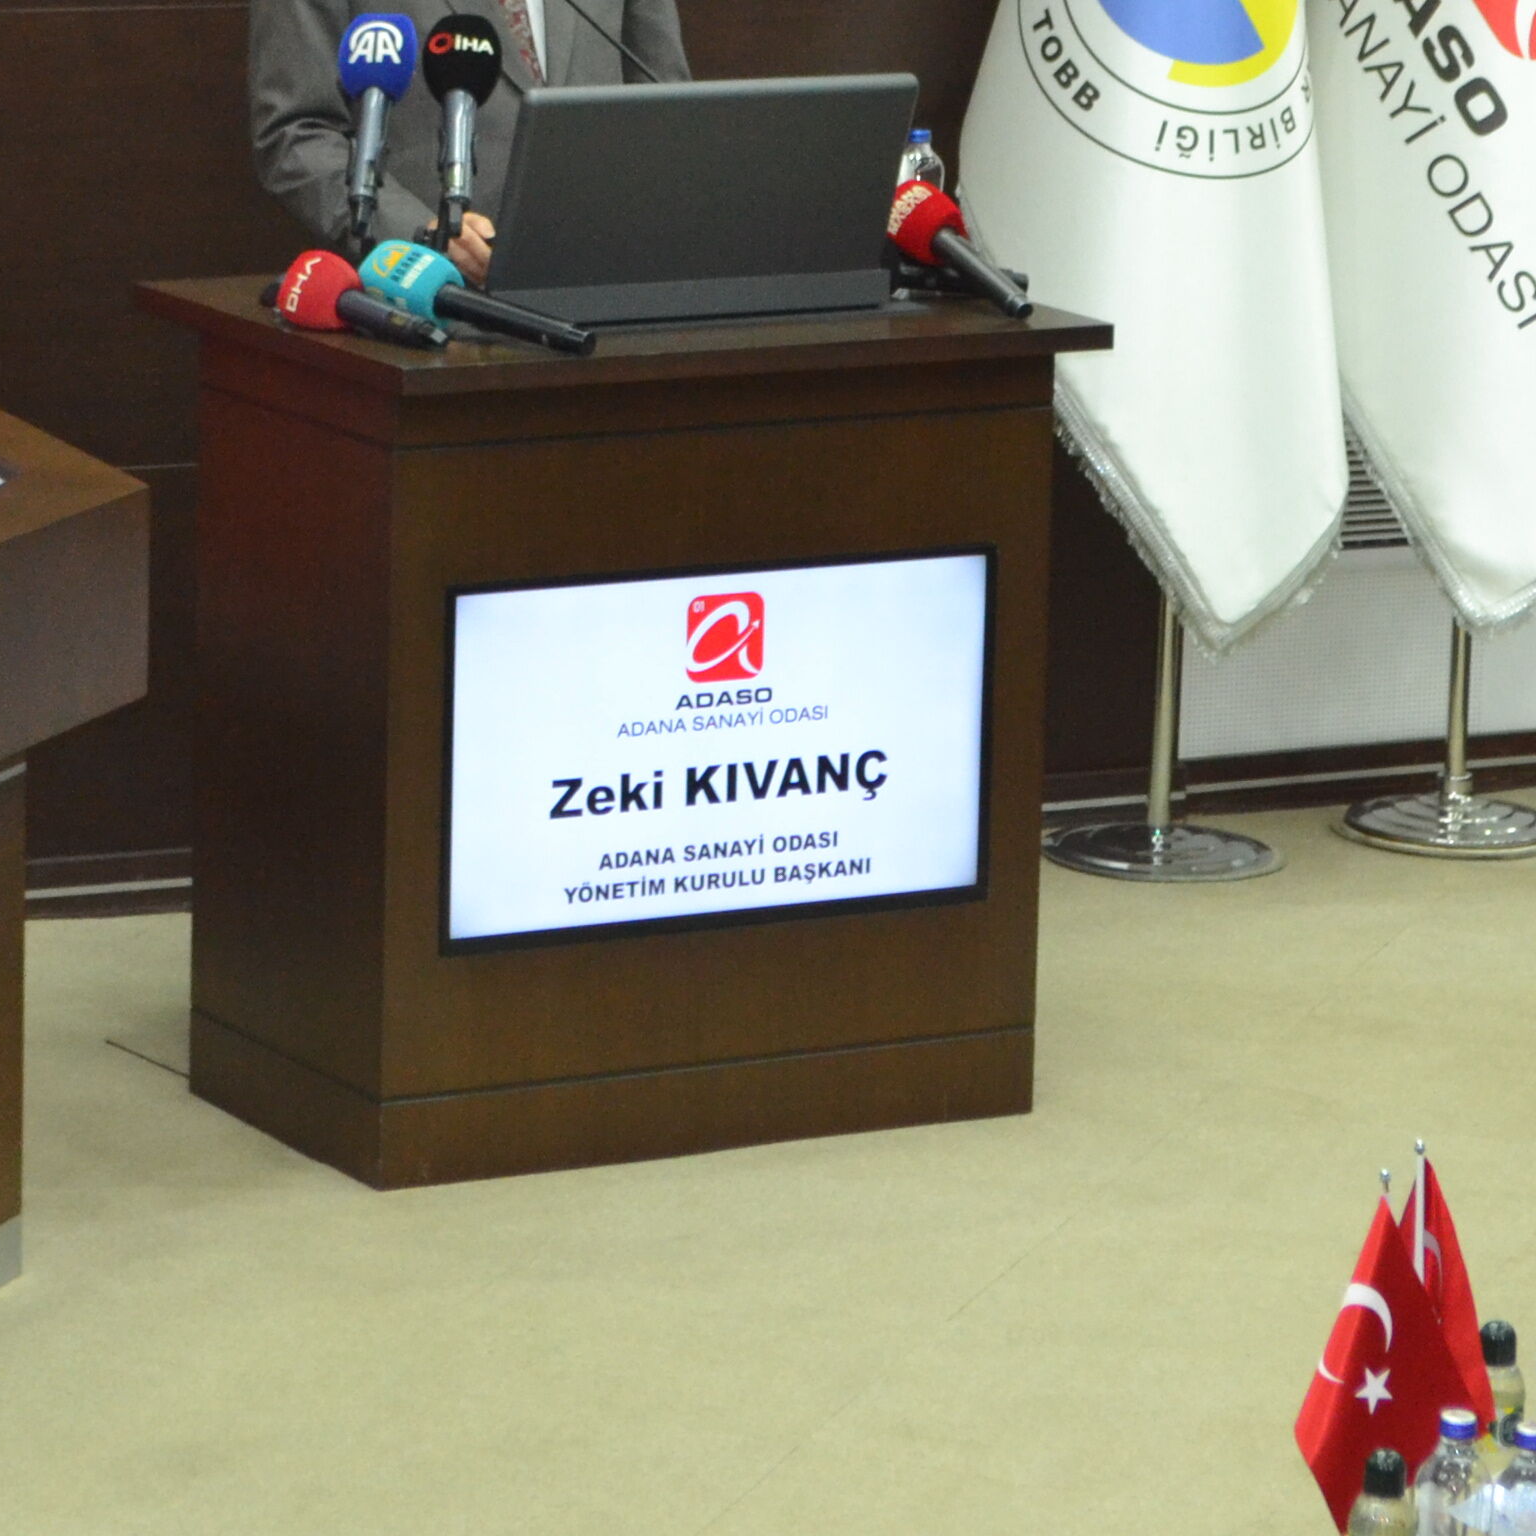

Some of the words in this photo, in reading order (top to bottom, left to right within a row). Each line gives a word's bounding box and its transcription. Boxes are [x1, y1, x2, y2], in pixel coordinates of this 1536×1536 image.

[348, 29, 403, 64] AA
[1032, 8, 1101, 111] TOBB
[1154, 105, 1297, 162] BİRLİĞİ
[284, 256, 323, 313] DHA
[616, 717, 687, 738] ADANA
[691, 707, 765, 733] SANAYİ
[768, 704, 830, 726] ODASI
[674, 686, 773, 711] ADASO
[548, 769, 665, 819] Zeki
[684, 749, 889, 807] KIVANÇ
[598, 847, 676, 871] ADANA
[682, 833, 765, 863] SANAYİ
[772, 830, 840, 854] ODASI
[563, 875, 666, 905] YÖNETİM
[673, 868, 767, 895] KURULU
[773, 856, 873, 885] BAŞKANI
